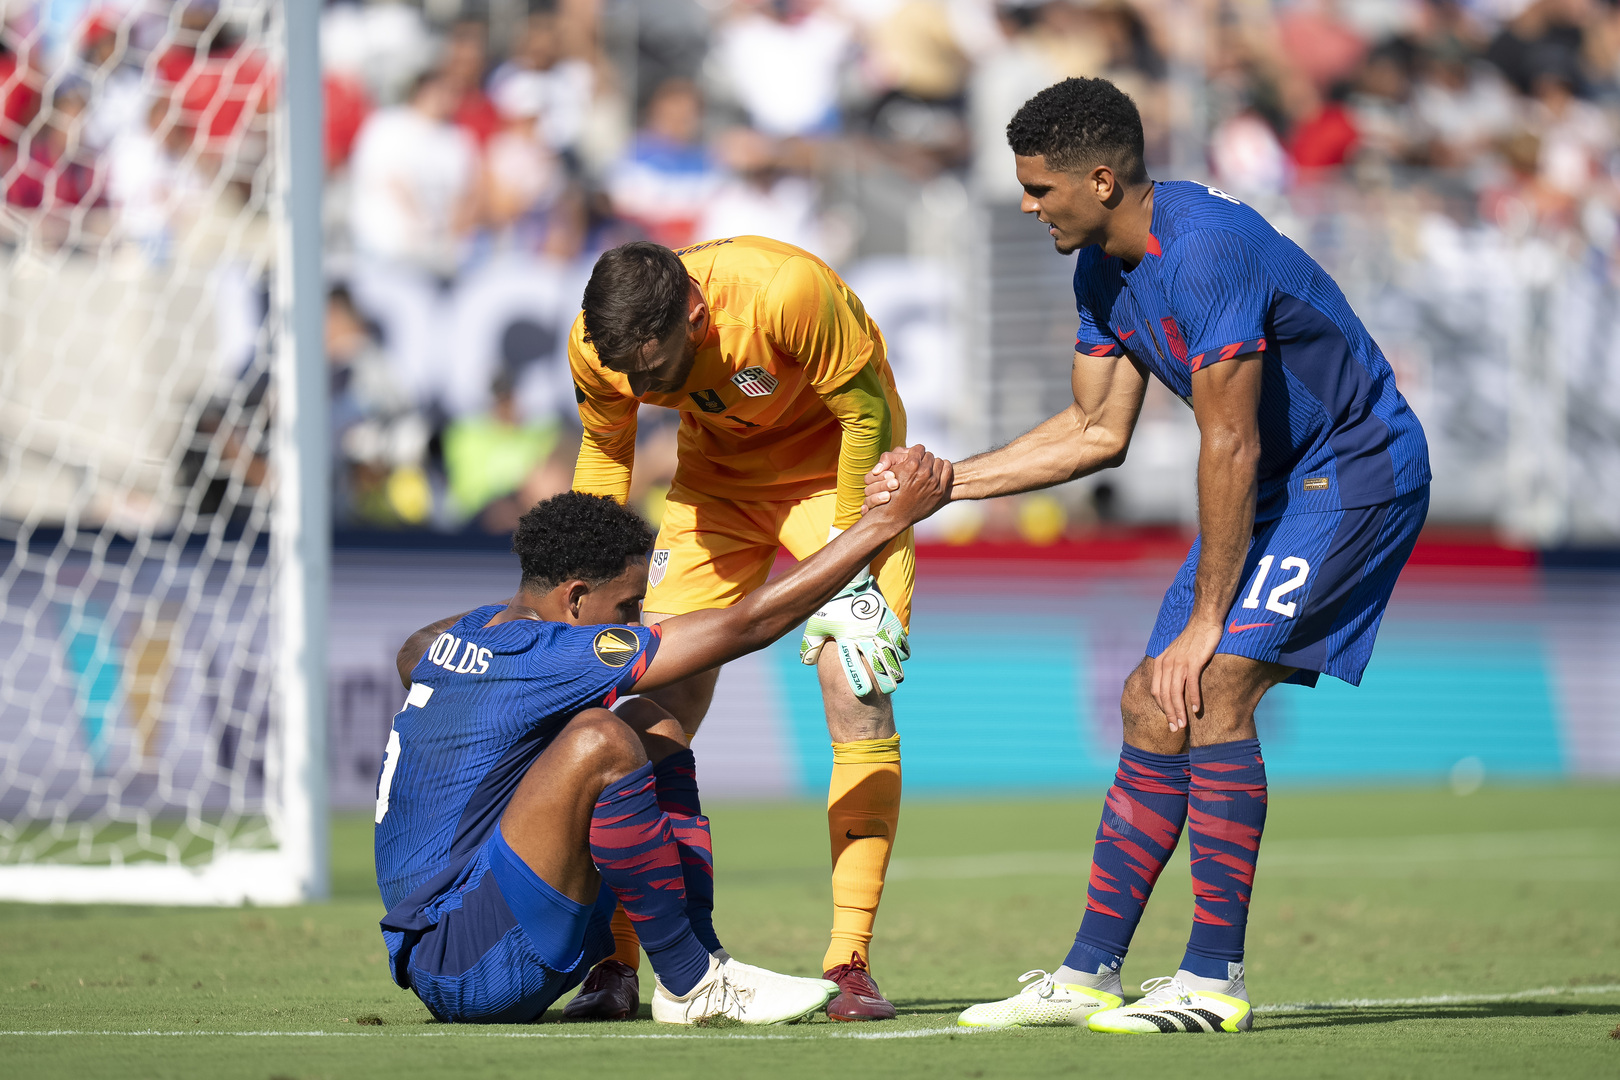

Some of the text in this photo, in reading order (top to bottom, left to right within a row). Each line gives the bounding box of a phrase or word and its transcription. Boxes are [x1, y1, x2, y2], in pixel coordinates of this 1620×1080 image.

[734, 366, 765, 385] USA
[653, 551, 669, 567] USA
[1242, 554, 1311, 618] 12
[841, 645, 863, 691] WEST COAST
